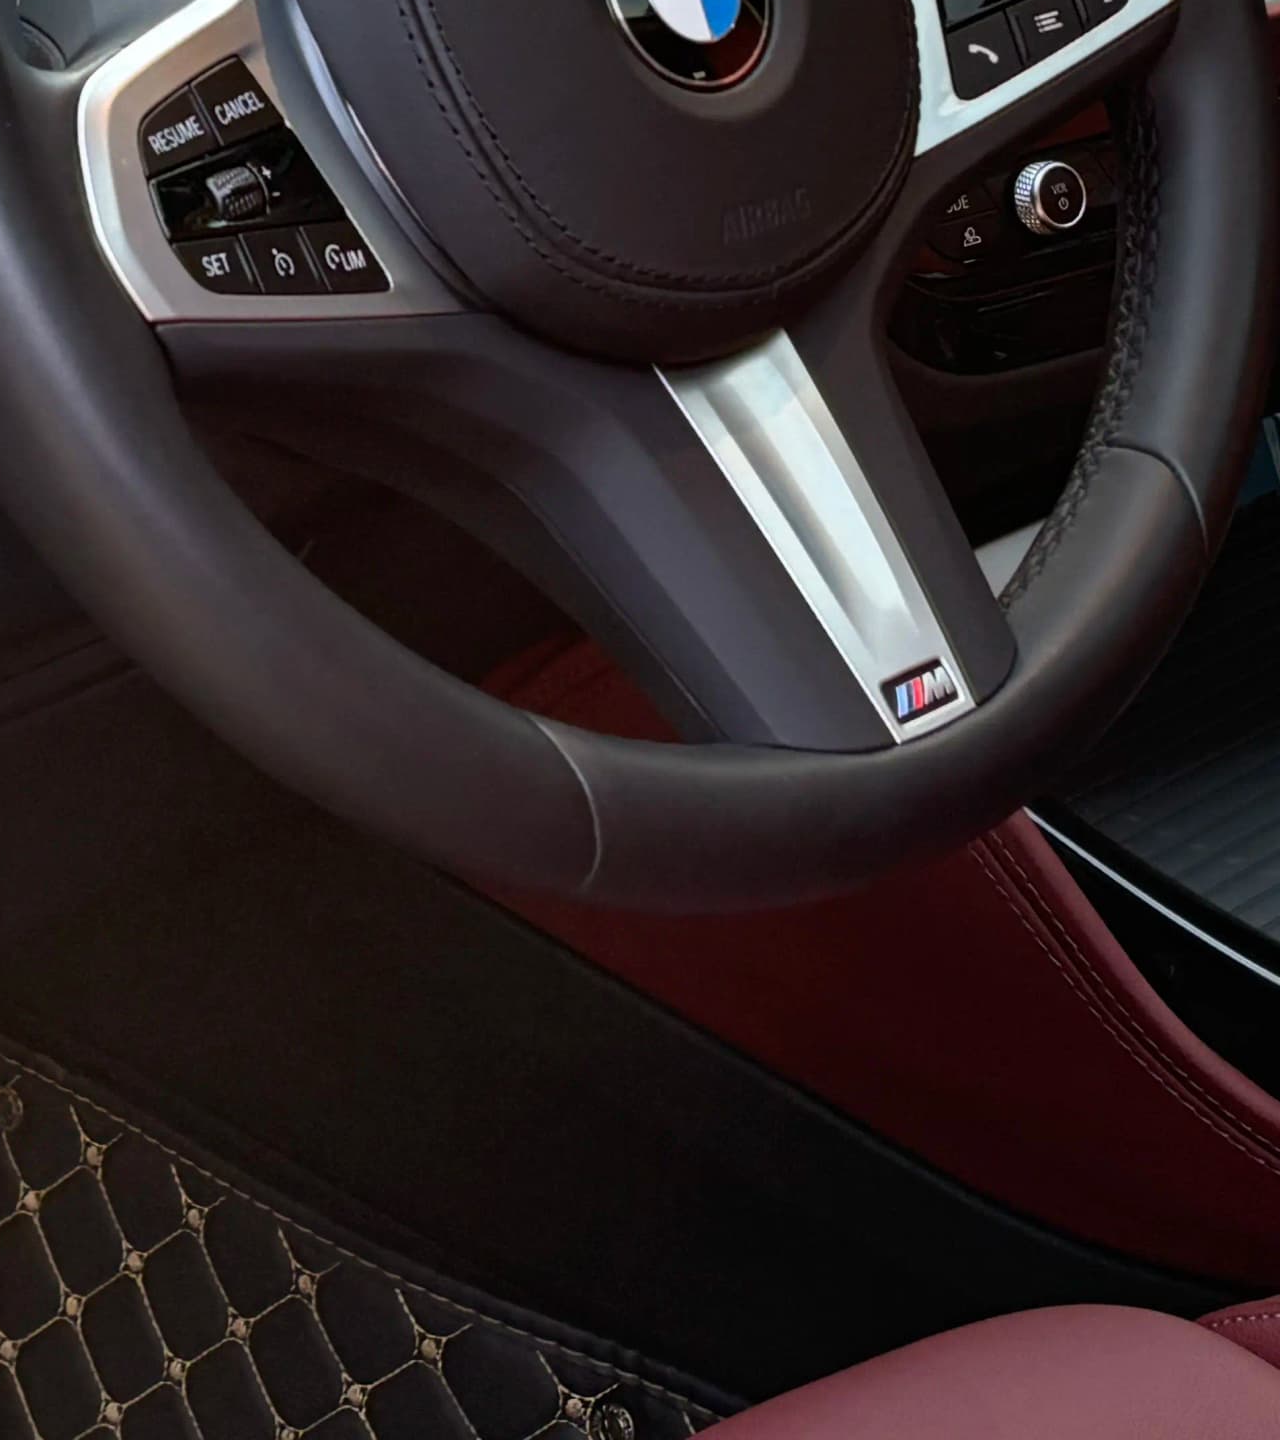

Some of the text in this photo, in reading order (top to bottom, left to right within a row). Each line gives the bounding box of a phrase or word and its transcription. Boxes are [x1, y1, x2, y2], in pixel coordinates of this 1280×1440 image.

[214, 91, 265, 125] CANCEL
[147, 115, 205, 156] RESUME
[1051, 182, 1068, 195] VOL
[202, 252, 231, 277] SET
[338, 249, 367, 271] LIM
